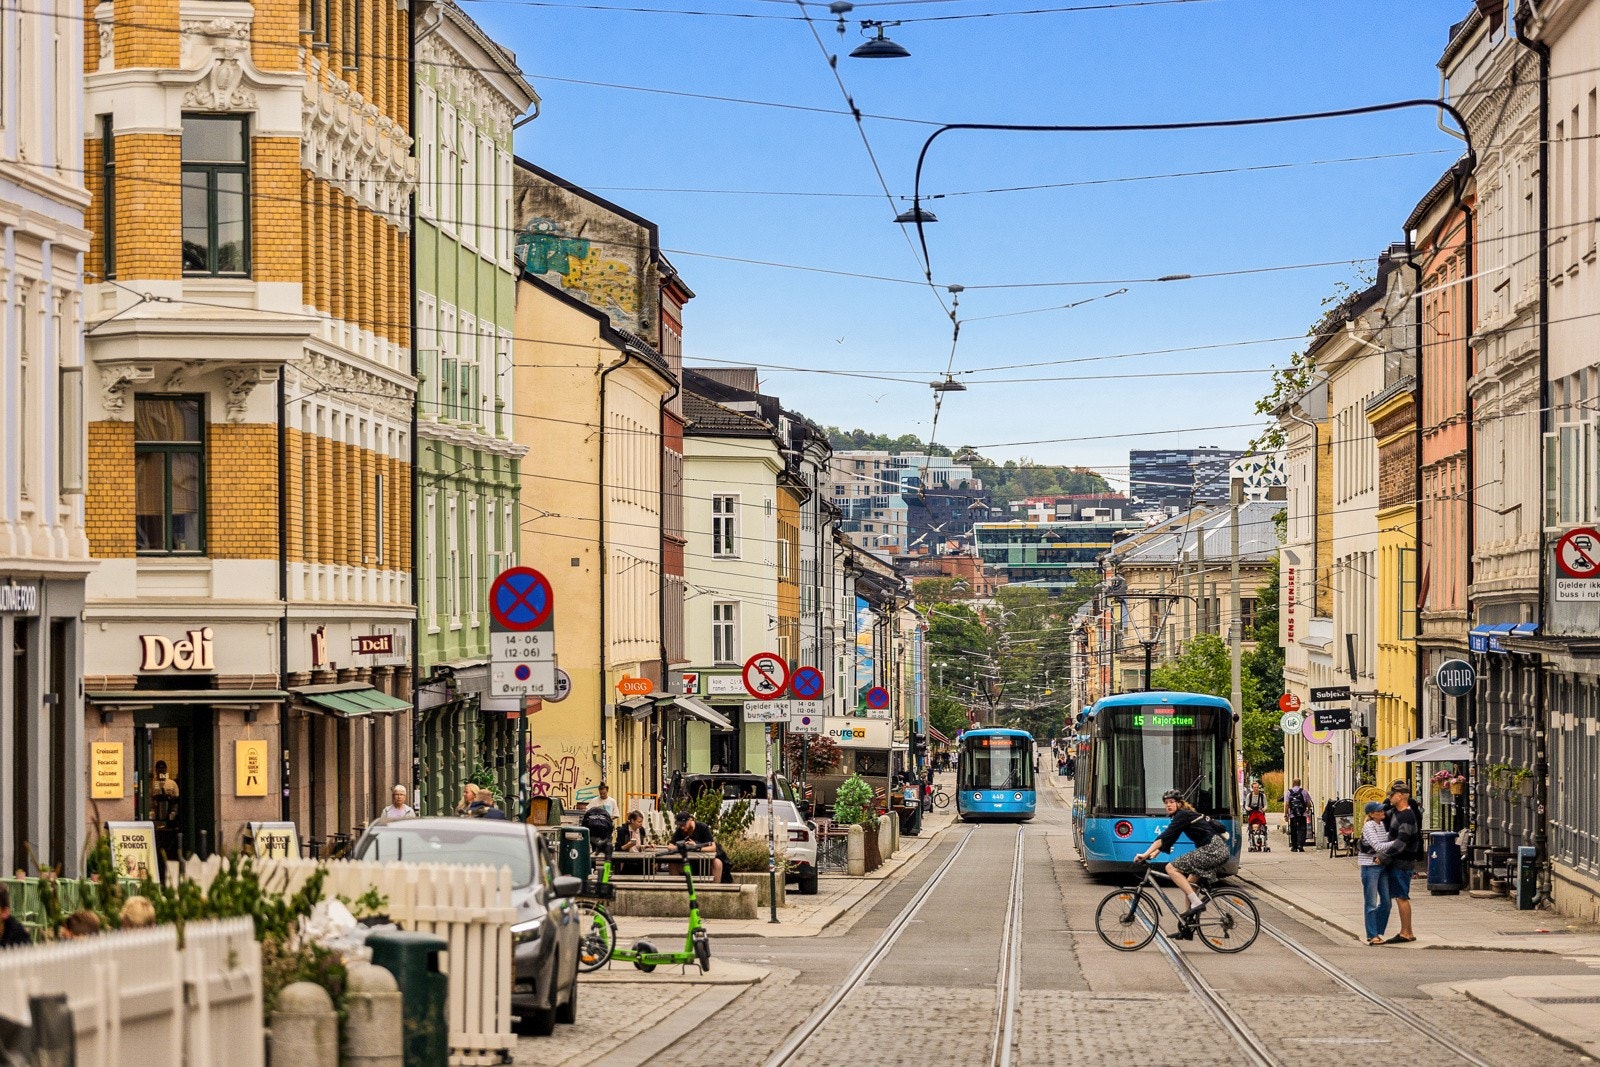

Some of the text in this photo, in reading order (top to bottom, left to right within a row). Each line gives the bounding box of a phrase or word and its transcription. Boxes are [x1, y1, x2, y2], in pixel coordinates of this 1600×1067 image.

[1558, 581, 1587, 590] Gjelder
[139, 626, 215, 671] Deli
[361, 637, 389, 652] Deli
[1440, 669, 1472, 687] CHAIR
[502, 683, 544, 694] Øvrig tid
[1316, 690, 1345, 699] Subjet
[745, 702, 789, 711] Gjelder ikke
[1134, 715, 1193, 727] 15 Majorstuen
[829, 728, 865, 739] eureca
[131, 834, 145, 842] GOD
[120, 842, 148, 850] FROKOST
